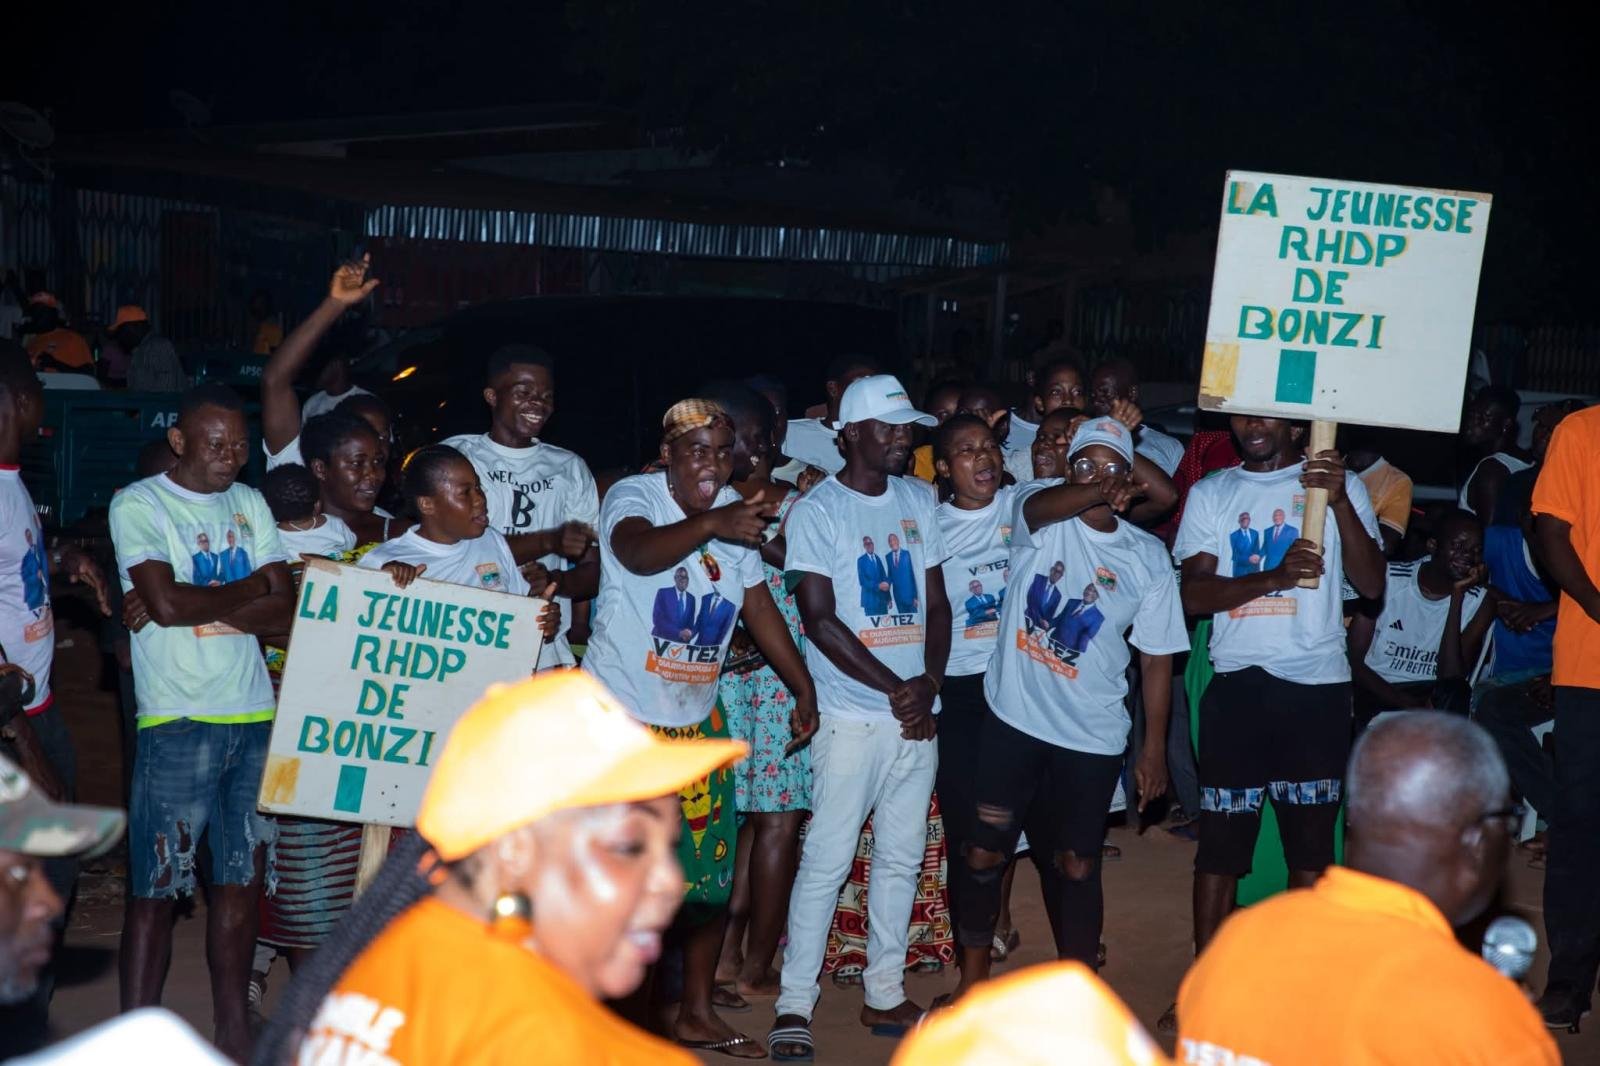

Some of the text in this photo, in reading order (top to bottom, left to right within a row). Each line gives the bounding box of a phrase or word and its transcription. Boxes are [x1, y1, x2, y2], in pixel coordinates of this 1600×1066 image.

[1227, 181, 1478, 234] LA JEUNESSE
[1278, 225, 1408, 268] RHDP
[1292, 267, 1349, 305] DE
[1237, 305, 1386, 350] BONZI
[511, 489, 535, 528] B
[968, 558, 1010, 577] VOTEZ
[299, 581, 515, 650] LA JEUNESSE
[870, 614, 915, 628] VOTEZ
[351, 634, 467, 682] RHDP
[653, 637, 720, 663] VOTEZ
[356, 679, 411, 720] DE
[297, 715, 437, 767] BONZI
